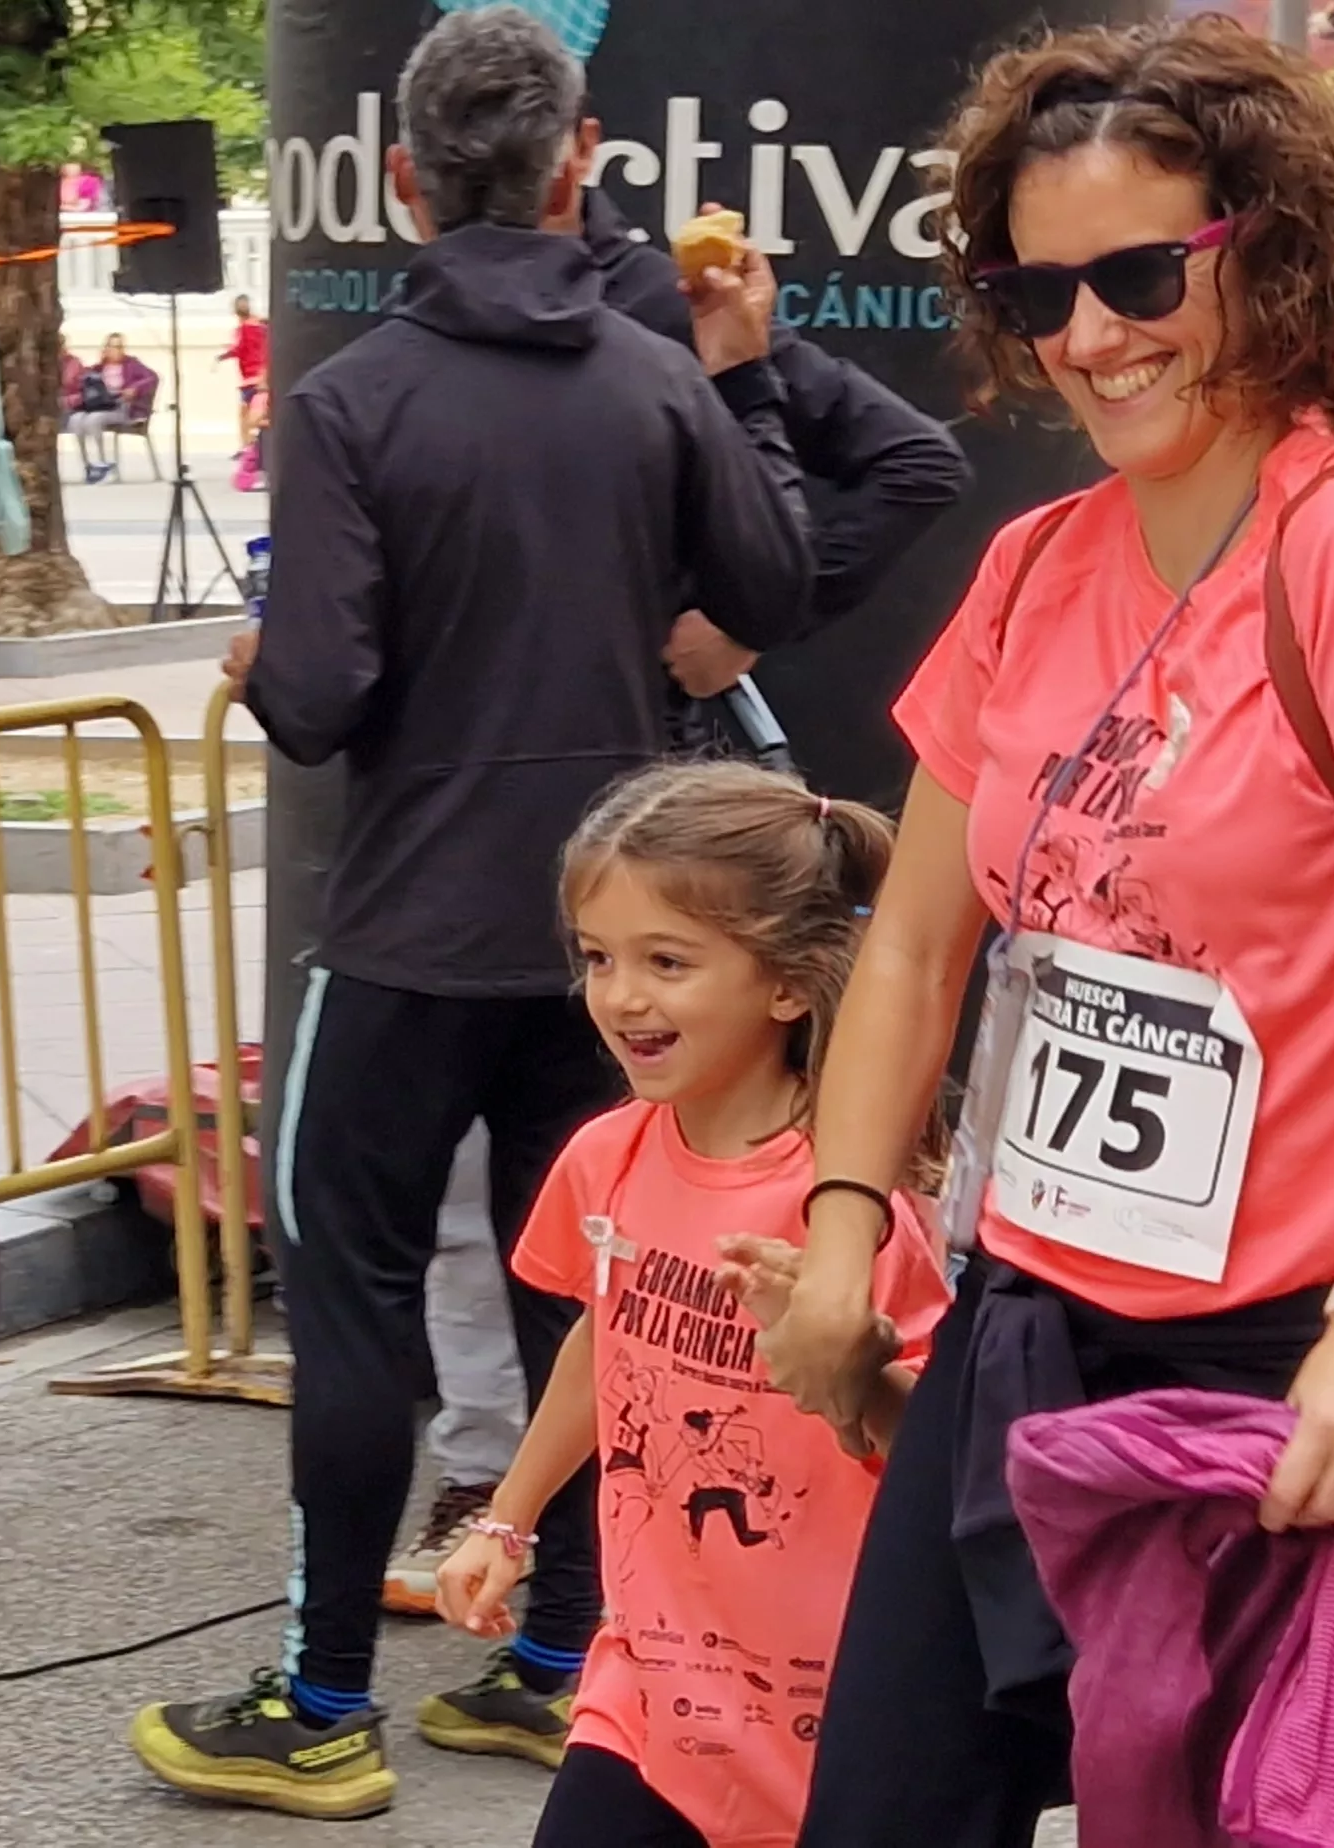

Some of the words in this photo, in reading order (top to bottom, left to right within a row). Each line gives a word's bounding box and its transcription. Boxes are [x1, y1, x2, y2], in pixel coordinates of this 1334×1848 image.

[1065, 976, 1127, 1014] HUESCA
[1075, 1005, 1100, 1038] EL
[1104, 1013, 1226, 1068] CÁNCER
[1023, 1040, 1172, 1174] 175
[608, 1288, 650, 1340] POR
[646, 1300, 671, 1349] LA
[672, 1310, 759, 1374] CIENCIA
